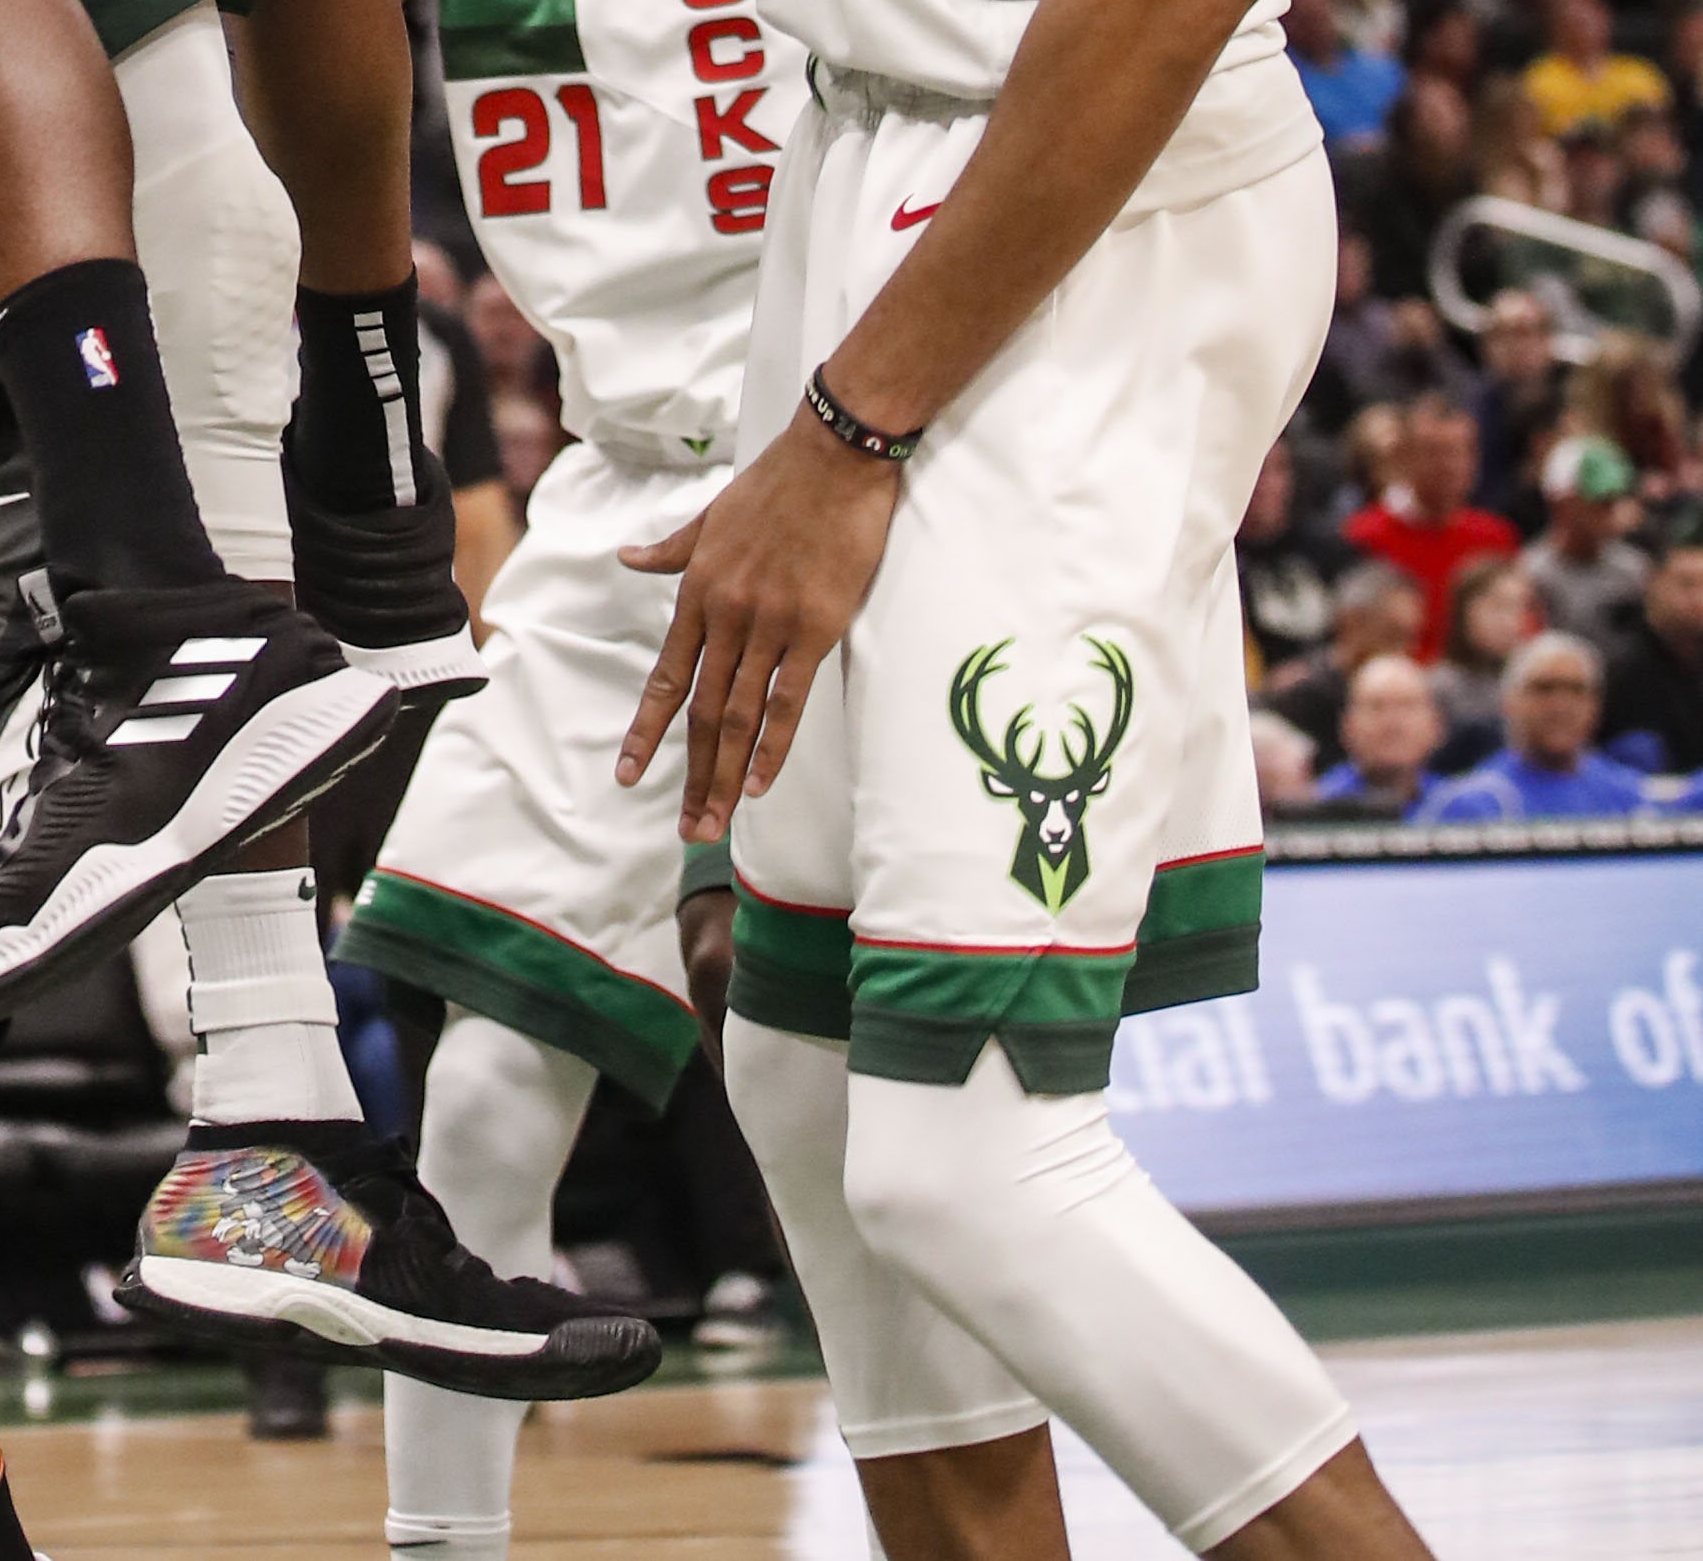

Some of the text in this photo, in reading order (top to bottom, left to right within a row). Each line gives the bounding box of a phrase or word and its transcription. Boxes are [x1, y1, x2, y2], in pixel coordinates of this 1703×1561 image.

[472, 83, 607, 218] 21
[1289, 951, 1587, 1105] bank
[1607, 947, 1703, 1089] of
